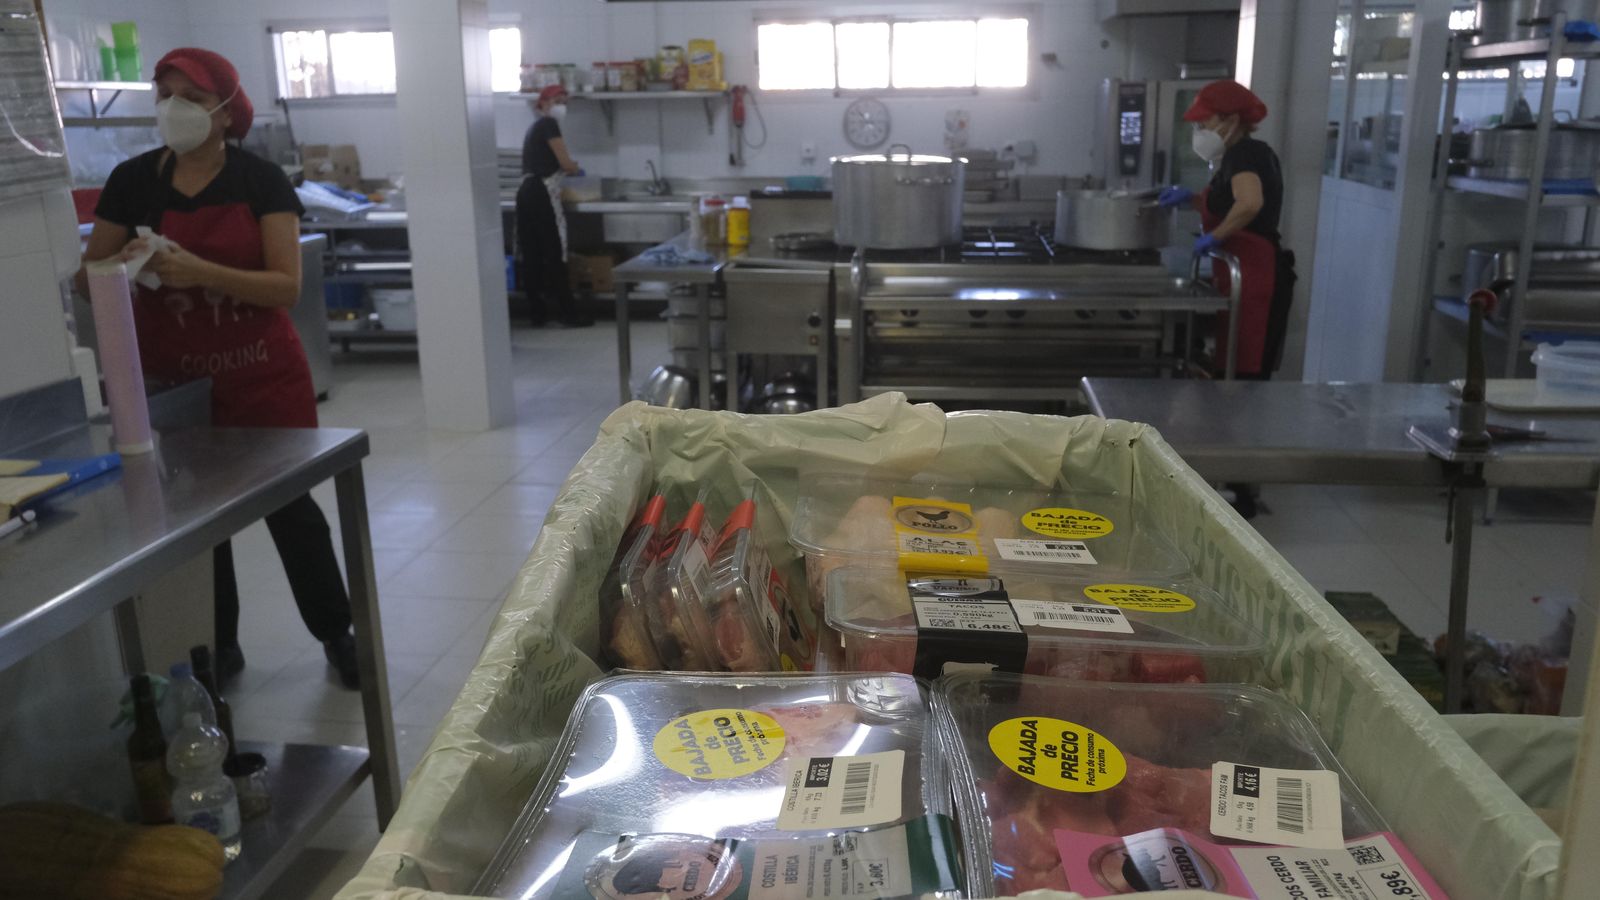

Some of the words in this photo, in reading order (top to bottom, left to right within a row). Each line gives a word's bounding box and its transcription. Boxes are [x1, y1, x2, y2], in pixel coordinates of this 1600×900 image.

[181, 338, 268, 375] COOKING
[911, 521, 958, 531] POLLO
[1030, 512, 1105, 522] BAJADA
[1036, 521, 1101, 531] PRECIO
[674, 718, 712, 776] BAJADA
[704, 735, 721, 750] de
[713, 716, 750, 765] PRECIO
[1018, 720, 1038, 776] BAJADA
[1040, 744, 1058, 759] de
[1087, 732, 1095, 758] consumo
[1061, 730, 1079, 781] PRECIO
[1087, 758, 1095, 767] de
[1097, 748, 1107, 775] próxima
[1086, 767, 1096, 786] Fecha
[786, 789, 799, 812] COSTILLA
[1218, 802, 1227, 817] CERDO
[762, 854, 778, 888] COSTILLA
[782, 854, 800, 884] IBÉRICA
[1171, 846, 1202, 888] CERDO
[1266, 855, 1295, 884] CERDO
[1295, 860, 1334, 898] FAMILIAR
[1285, 884, 1309, 900] COS
[1380, 870, 1421, 900] ,89€
